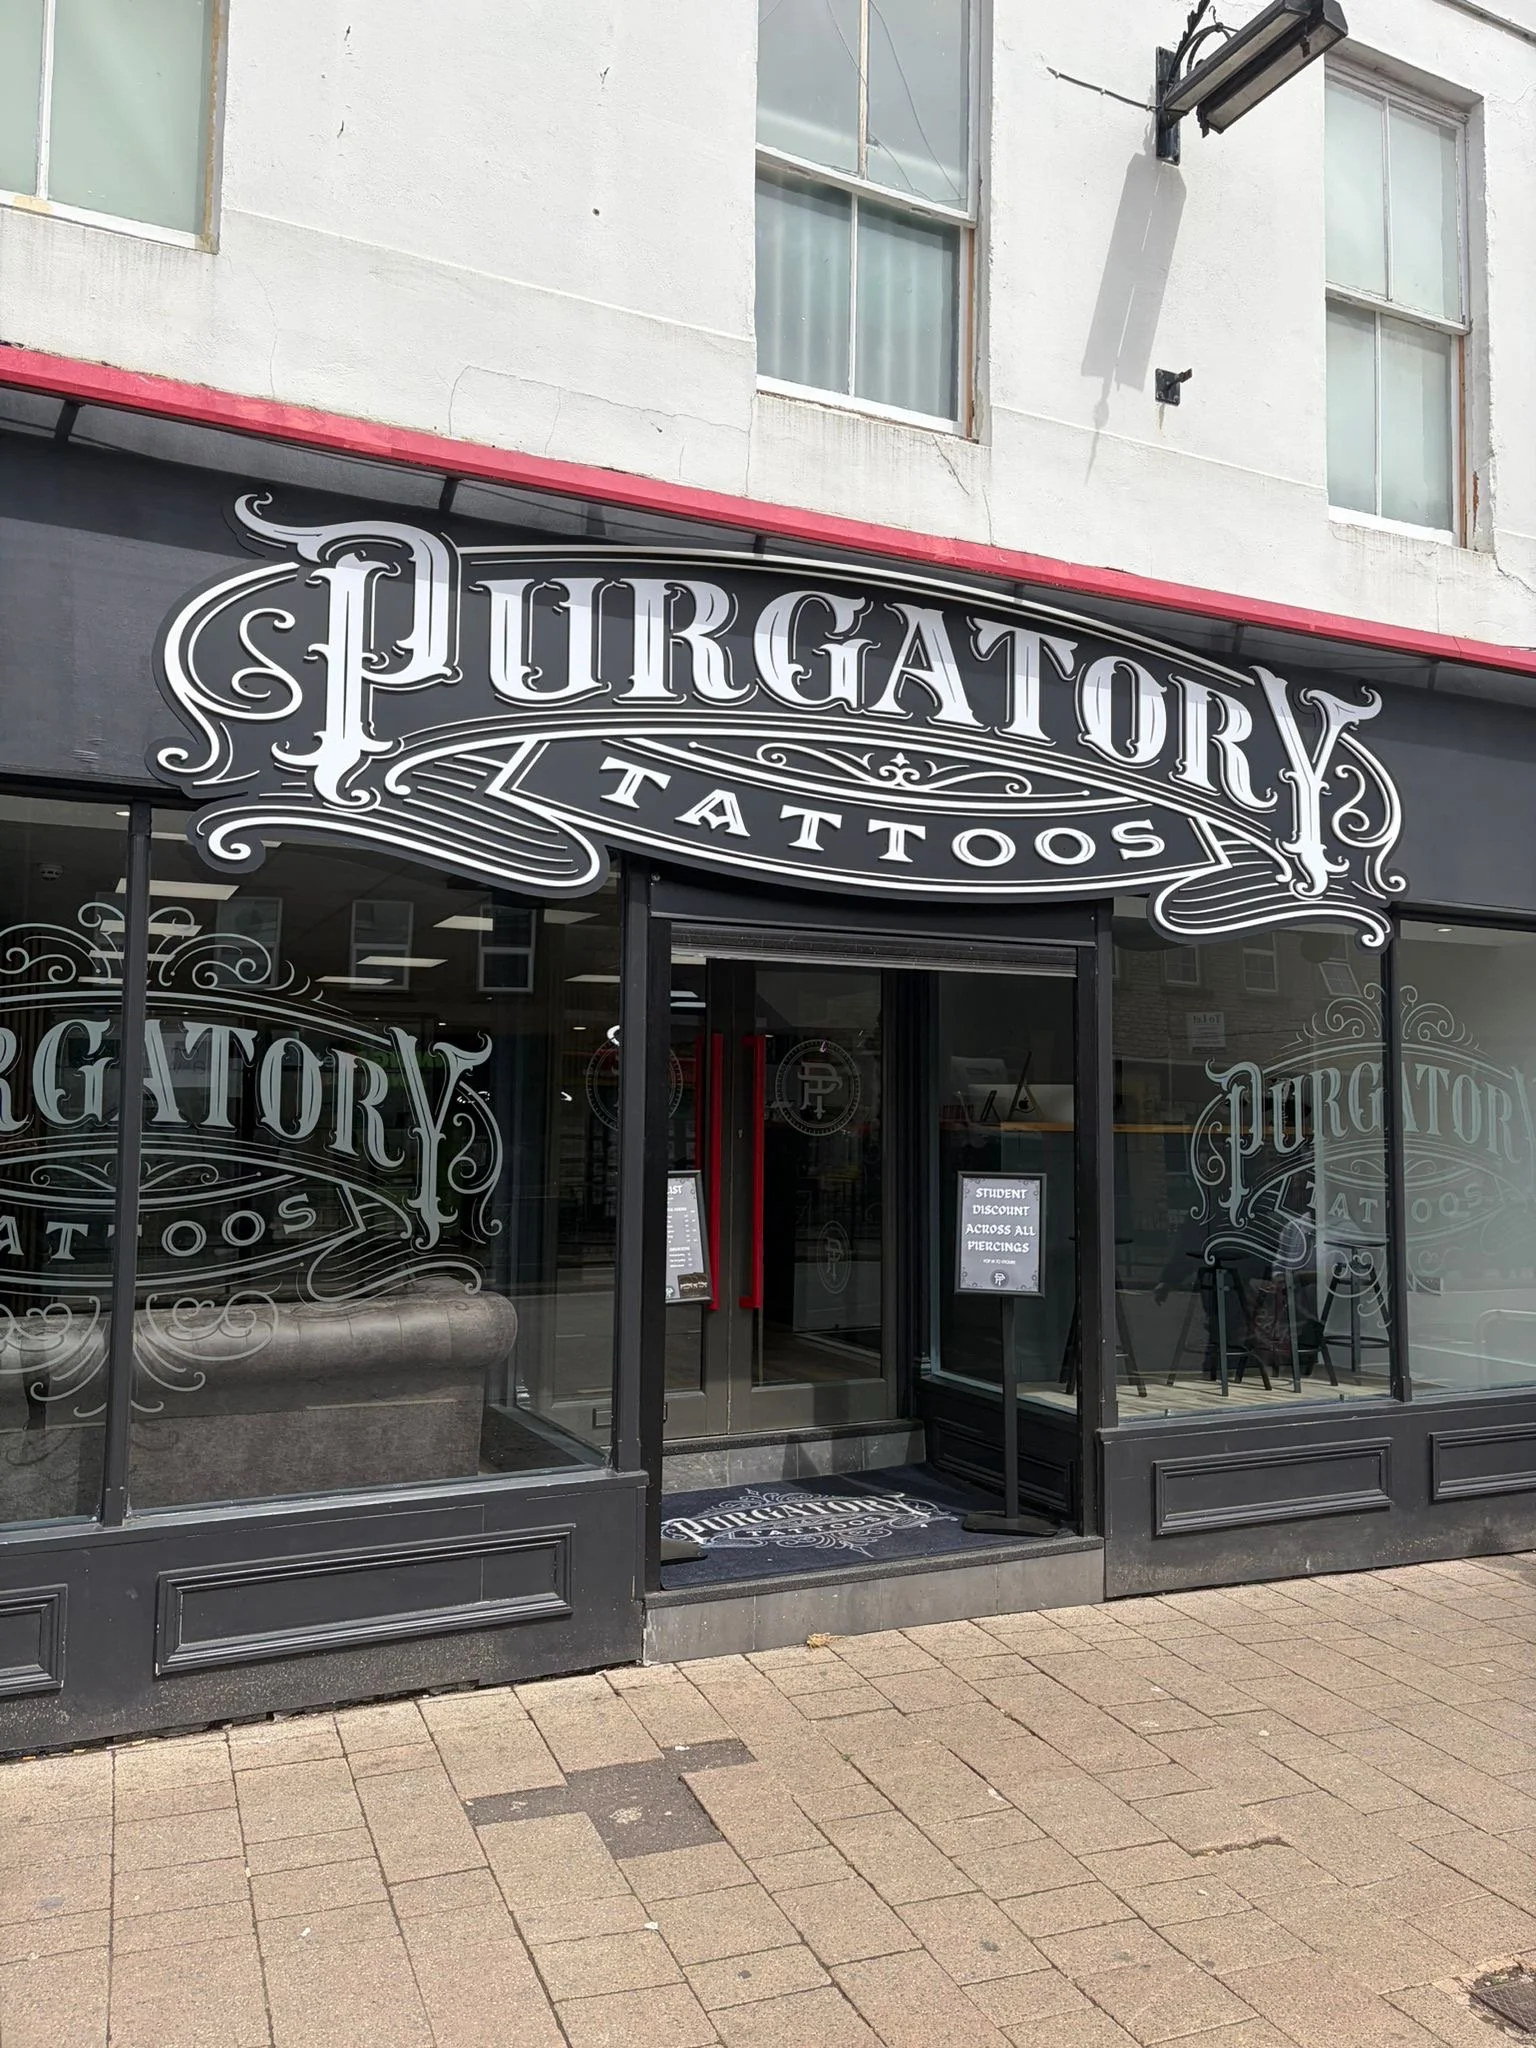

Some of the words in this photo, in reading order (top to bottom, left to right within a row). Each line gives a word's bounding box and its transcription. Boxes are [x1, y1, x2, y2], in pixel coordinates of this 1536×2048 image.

[235, 490, 1383, 897] PURGATORY
[600, 756, 1166, 868] TATTOOS
[975, 1188, 1028, 1200] STUDENT
[972, 1204, 1031, 1217] DISCOUNT
[965, 1223, 1012, 1236] ACROSS
[1014, 1225, 1036, 1237] ALL
[967, 1240, 1030, 1254] PIERCINGS
[661, 1493, 930, 1546] PURGATORY
[749, 1516, 881, 1537] TATTOOS
